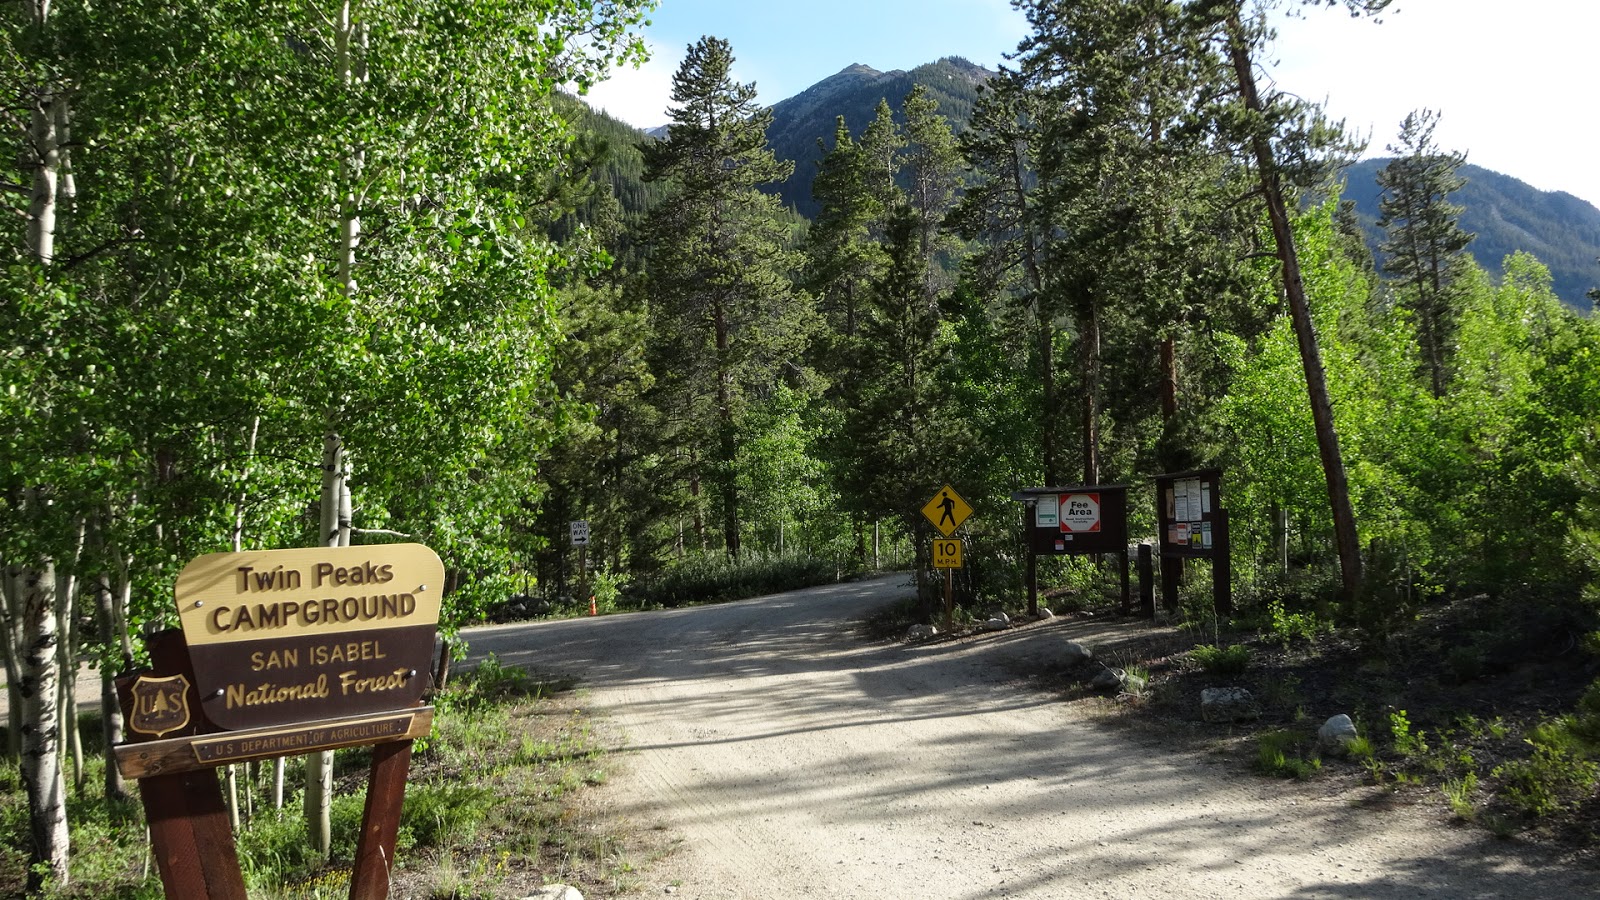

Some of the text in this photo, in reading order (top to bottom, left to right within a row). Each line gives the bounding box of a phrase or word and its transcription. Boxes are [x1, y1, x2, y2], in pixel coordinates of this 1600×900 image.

[938, 542, 956, 556] 10
[237, 560, 394, 592] Twin Peaks
[211, 592, 416, 631] CAMPGROUND
[250, 640, 386, 672] SAN ISABEL
[225, 667, 408, 710] National Forest
[241, 734, 309, 753] DEPARTMENT
[313, 730, 326, 743] OF
[330, 722, 394, 740] AGRICULTURE
